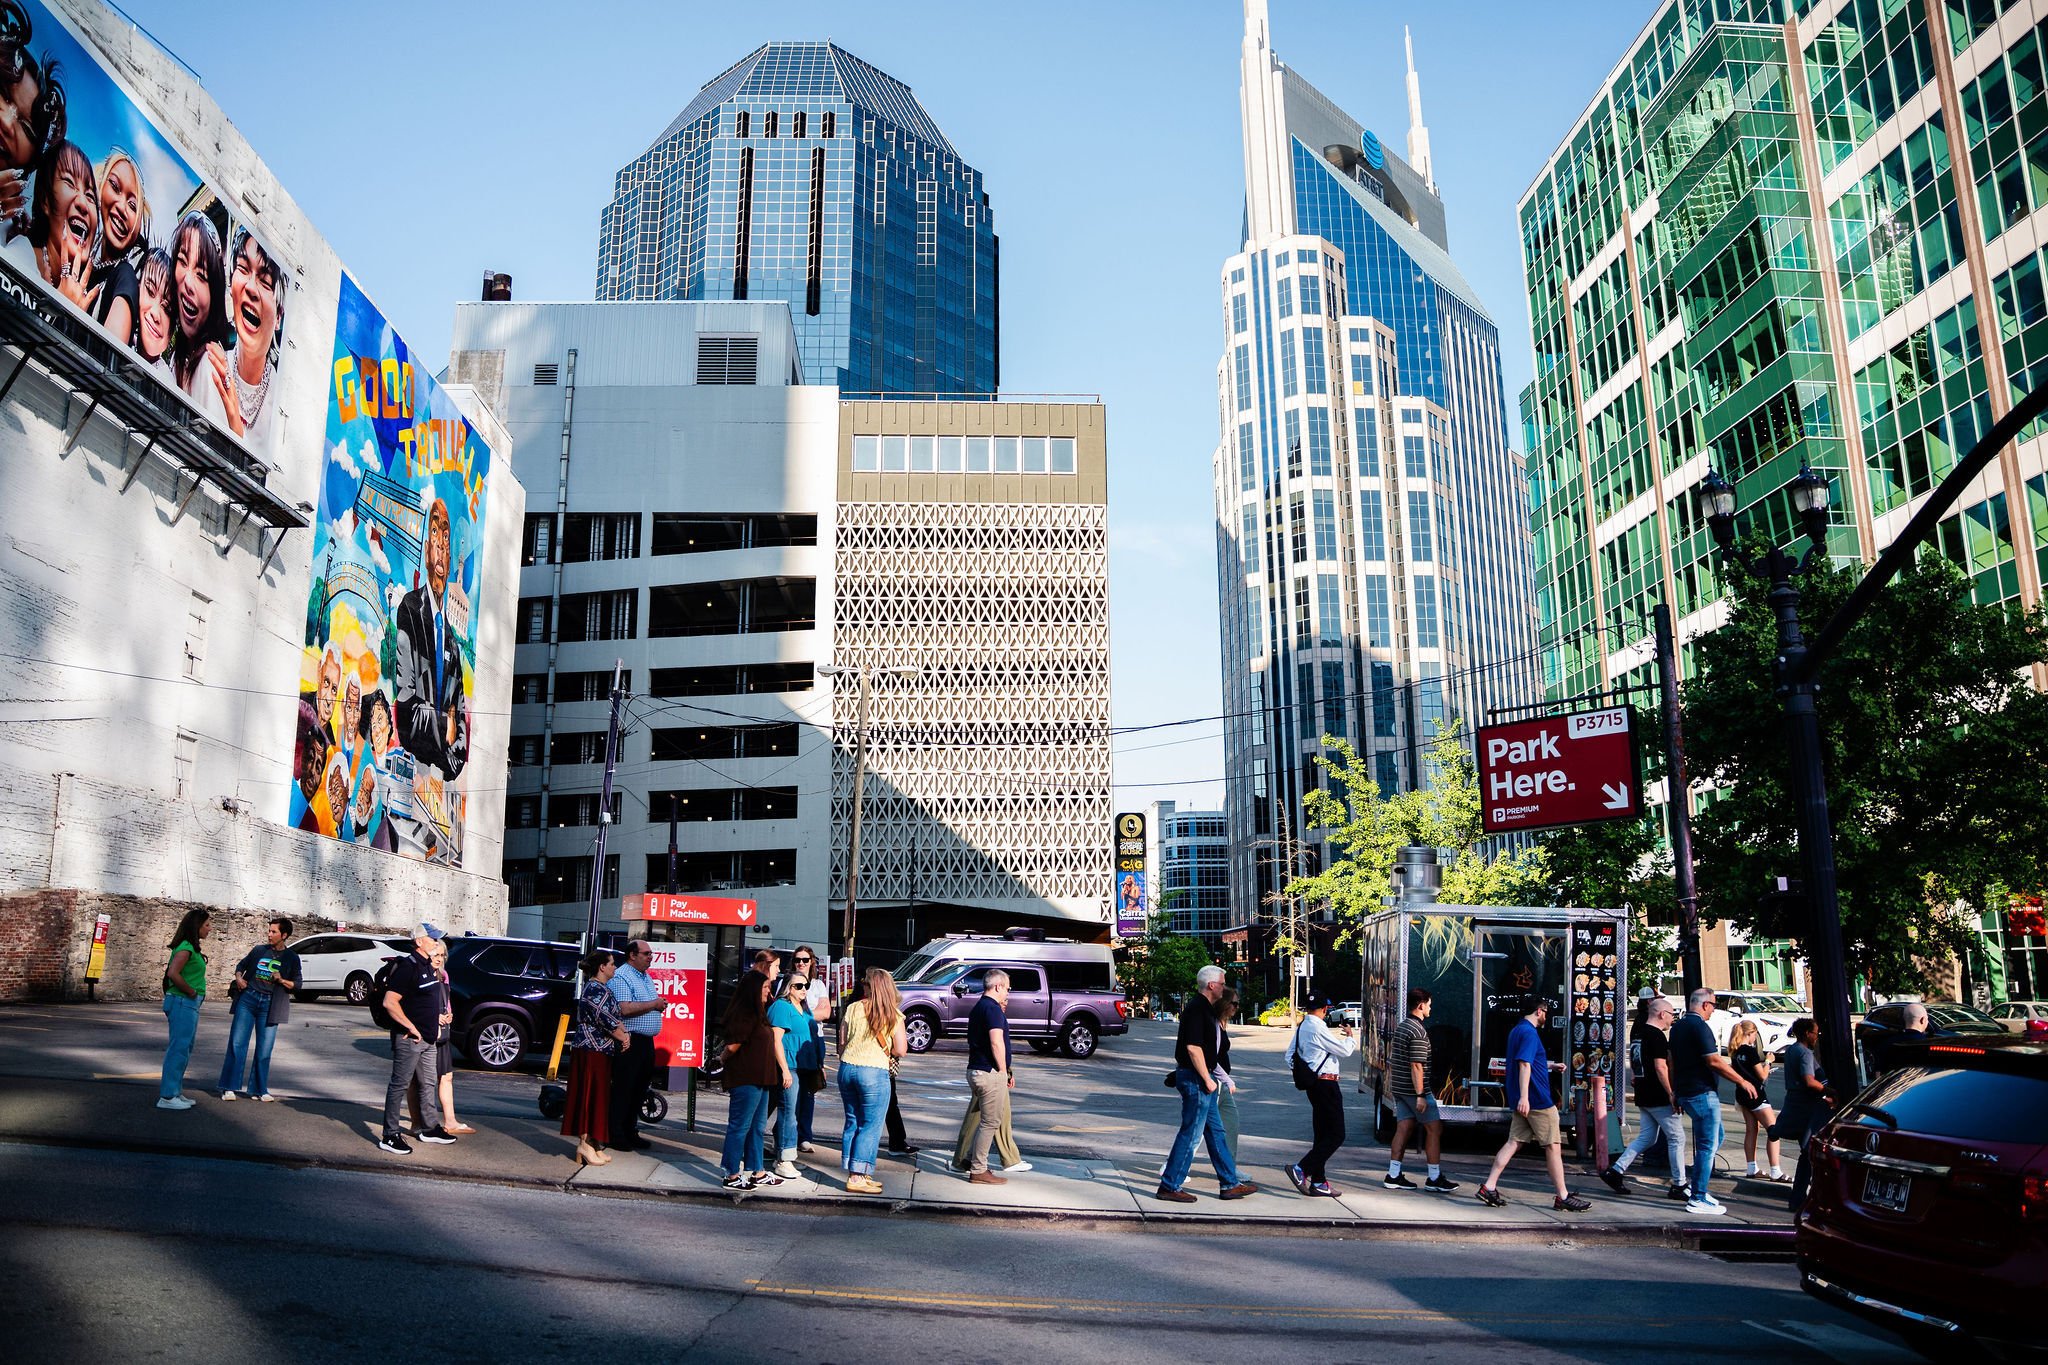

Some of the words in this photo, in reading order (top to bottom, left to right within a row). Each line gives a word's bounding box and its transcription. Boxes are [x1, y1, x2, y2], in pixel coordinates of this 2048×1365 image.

[334, 356, 415, 424] GOOD
[398, 418, 484, 524] TROUBLE
[1576, 712, 1623, 731] P3715
[1488, 730, 1561, 767] Park
[1490, 770, 1576, 800] Here.
[1506, 804, 1539, 815] PREMIUM
[670, 899, 688, 909] Pay
[670, 909, 709, 919] Machine.
[652, 952, 676, 963] 715
[652, 974, 688, 996] ark
[661, 1002, 695, 1019] re.
